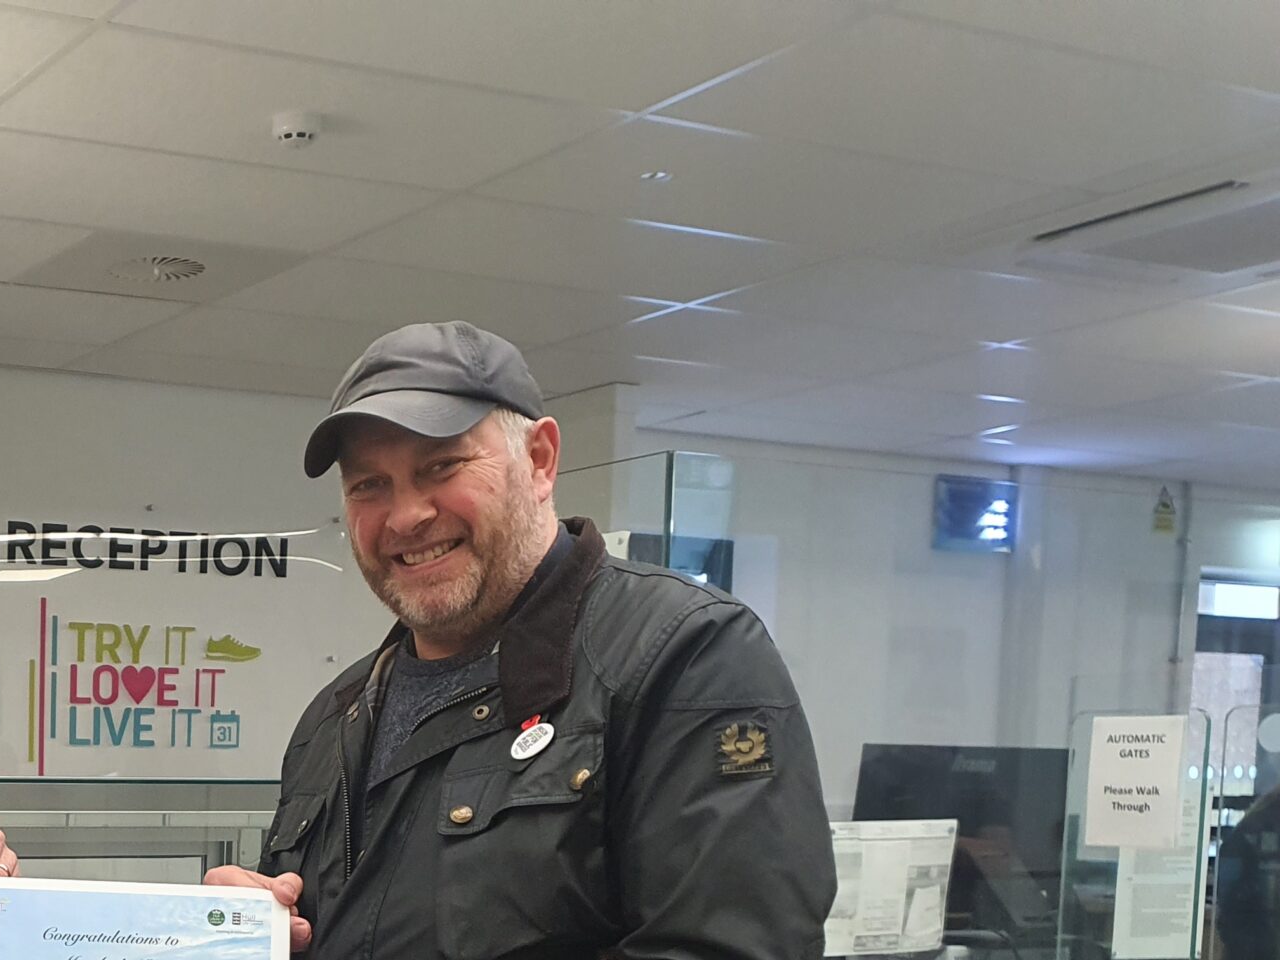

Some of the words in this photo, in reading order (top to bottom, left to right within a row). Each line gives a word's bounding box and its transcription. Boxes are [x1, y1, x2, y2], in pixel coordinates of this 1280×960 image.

[7, 520, 289, 578] RECEPTION
[68, 621, 151, 664] TRY
[164, 626, 196, 666] IT
[194, 668, 226, 707] IT
[69, 705, 156, 748] LIVE
[170, 708, 202, 748] IT
[1106, 734, 1167, 744] AUTOMATIC
[1119, 749, 1151, 759] GATES
[1104, 785, 1134, 795] Please
[1136, 786, 1161, 796] Walk
[1112, 801, 1151, 813] Through
[42, 927, 161, 946] Congratulations
[165, 936, 179, 946] to
